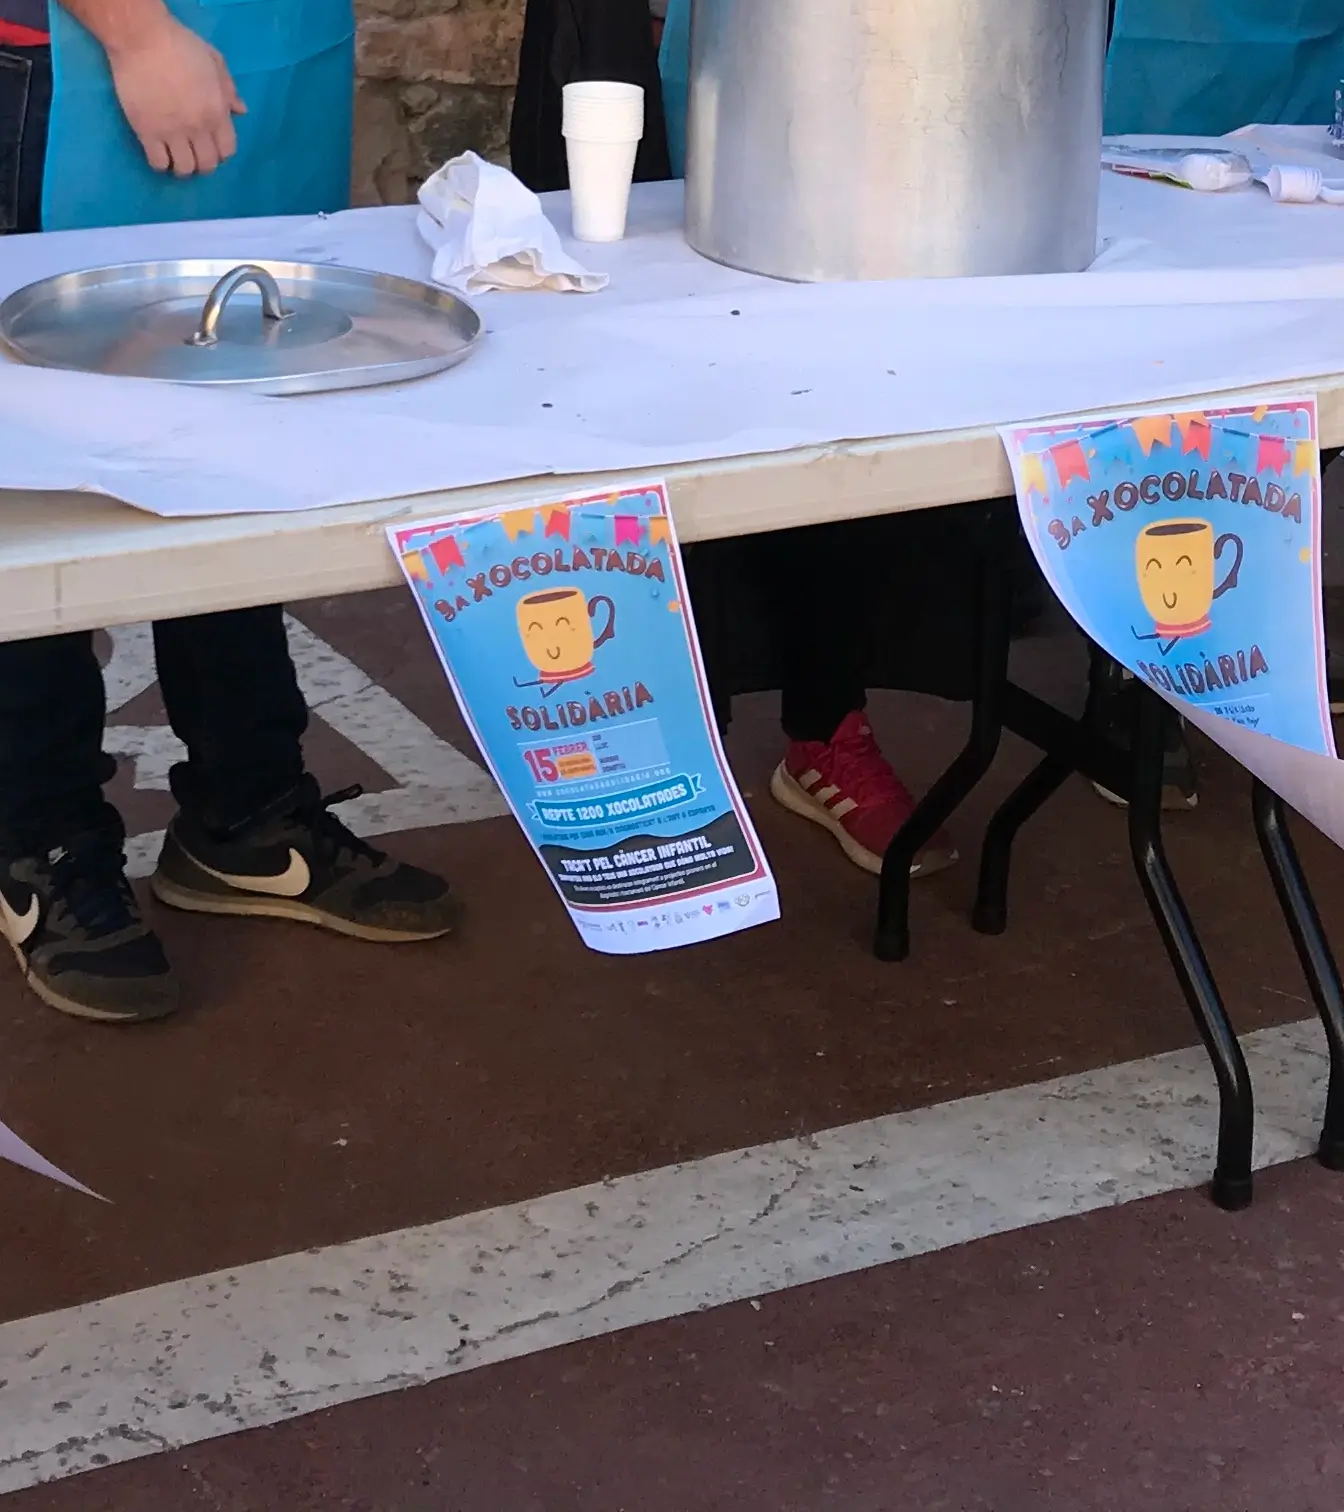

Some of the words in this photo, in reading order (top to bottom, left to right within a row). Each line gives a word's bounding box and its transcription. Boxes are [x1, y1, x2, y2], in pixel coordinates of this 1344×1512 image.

[1087, 467, 1302, 528] XOCOLATADA
[465, 545, 666, 604] XOCOLATADA
[504, 681, 654, 733] SOLIDÀRIA
[523, 748, 559, 783] 15
[541, 807, 576, 823] REPTE
[577, 805, 605, 821] 1200
[606, 783, 688, 817] XOCOLATADES
[593, 856, 613, 871] PEL
[613, 848, 657, 867] CÀNCER
[657, 835, 712, 859] INFANTIL
